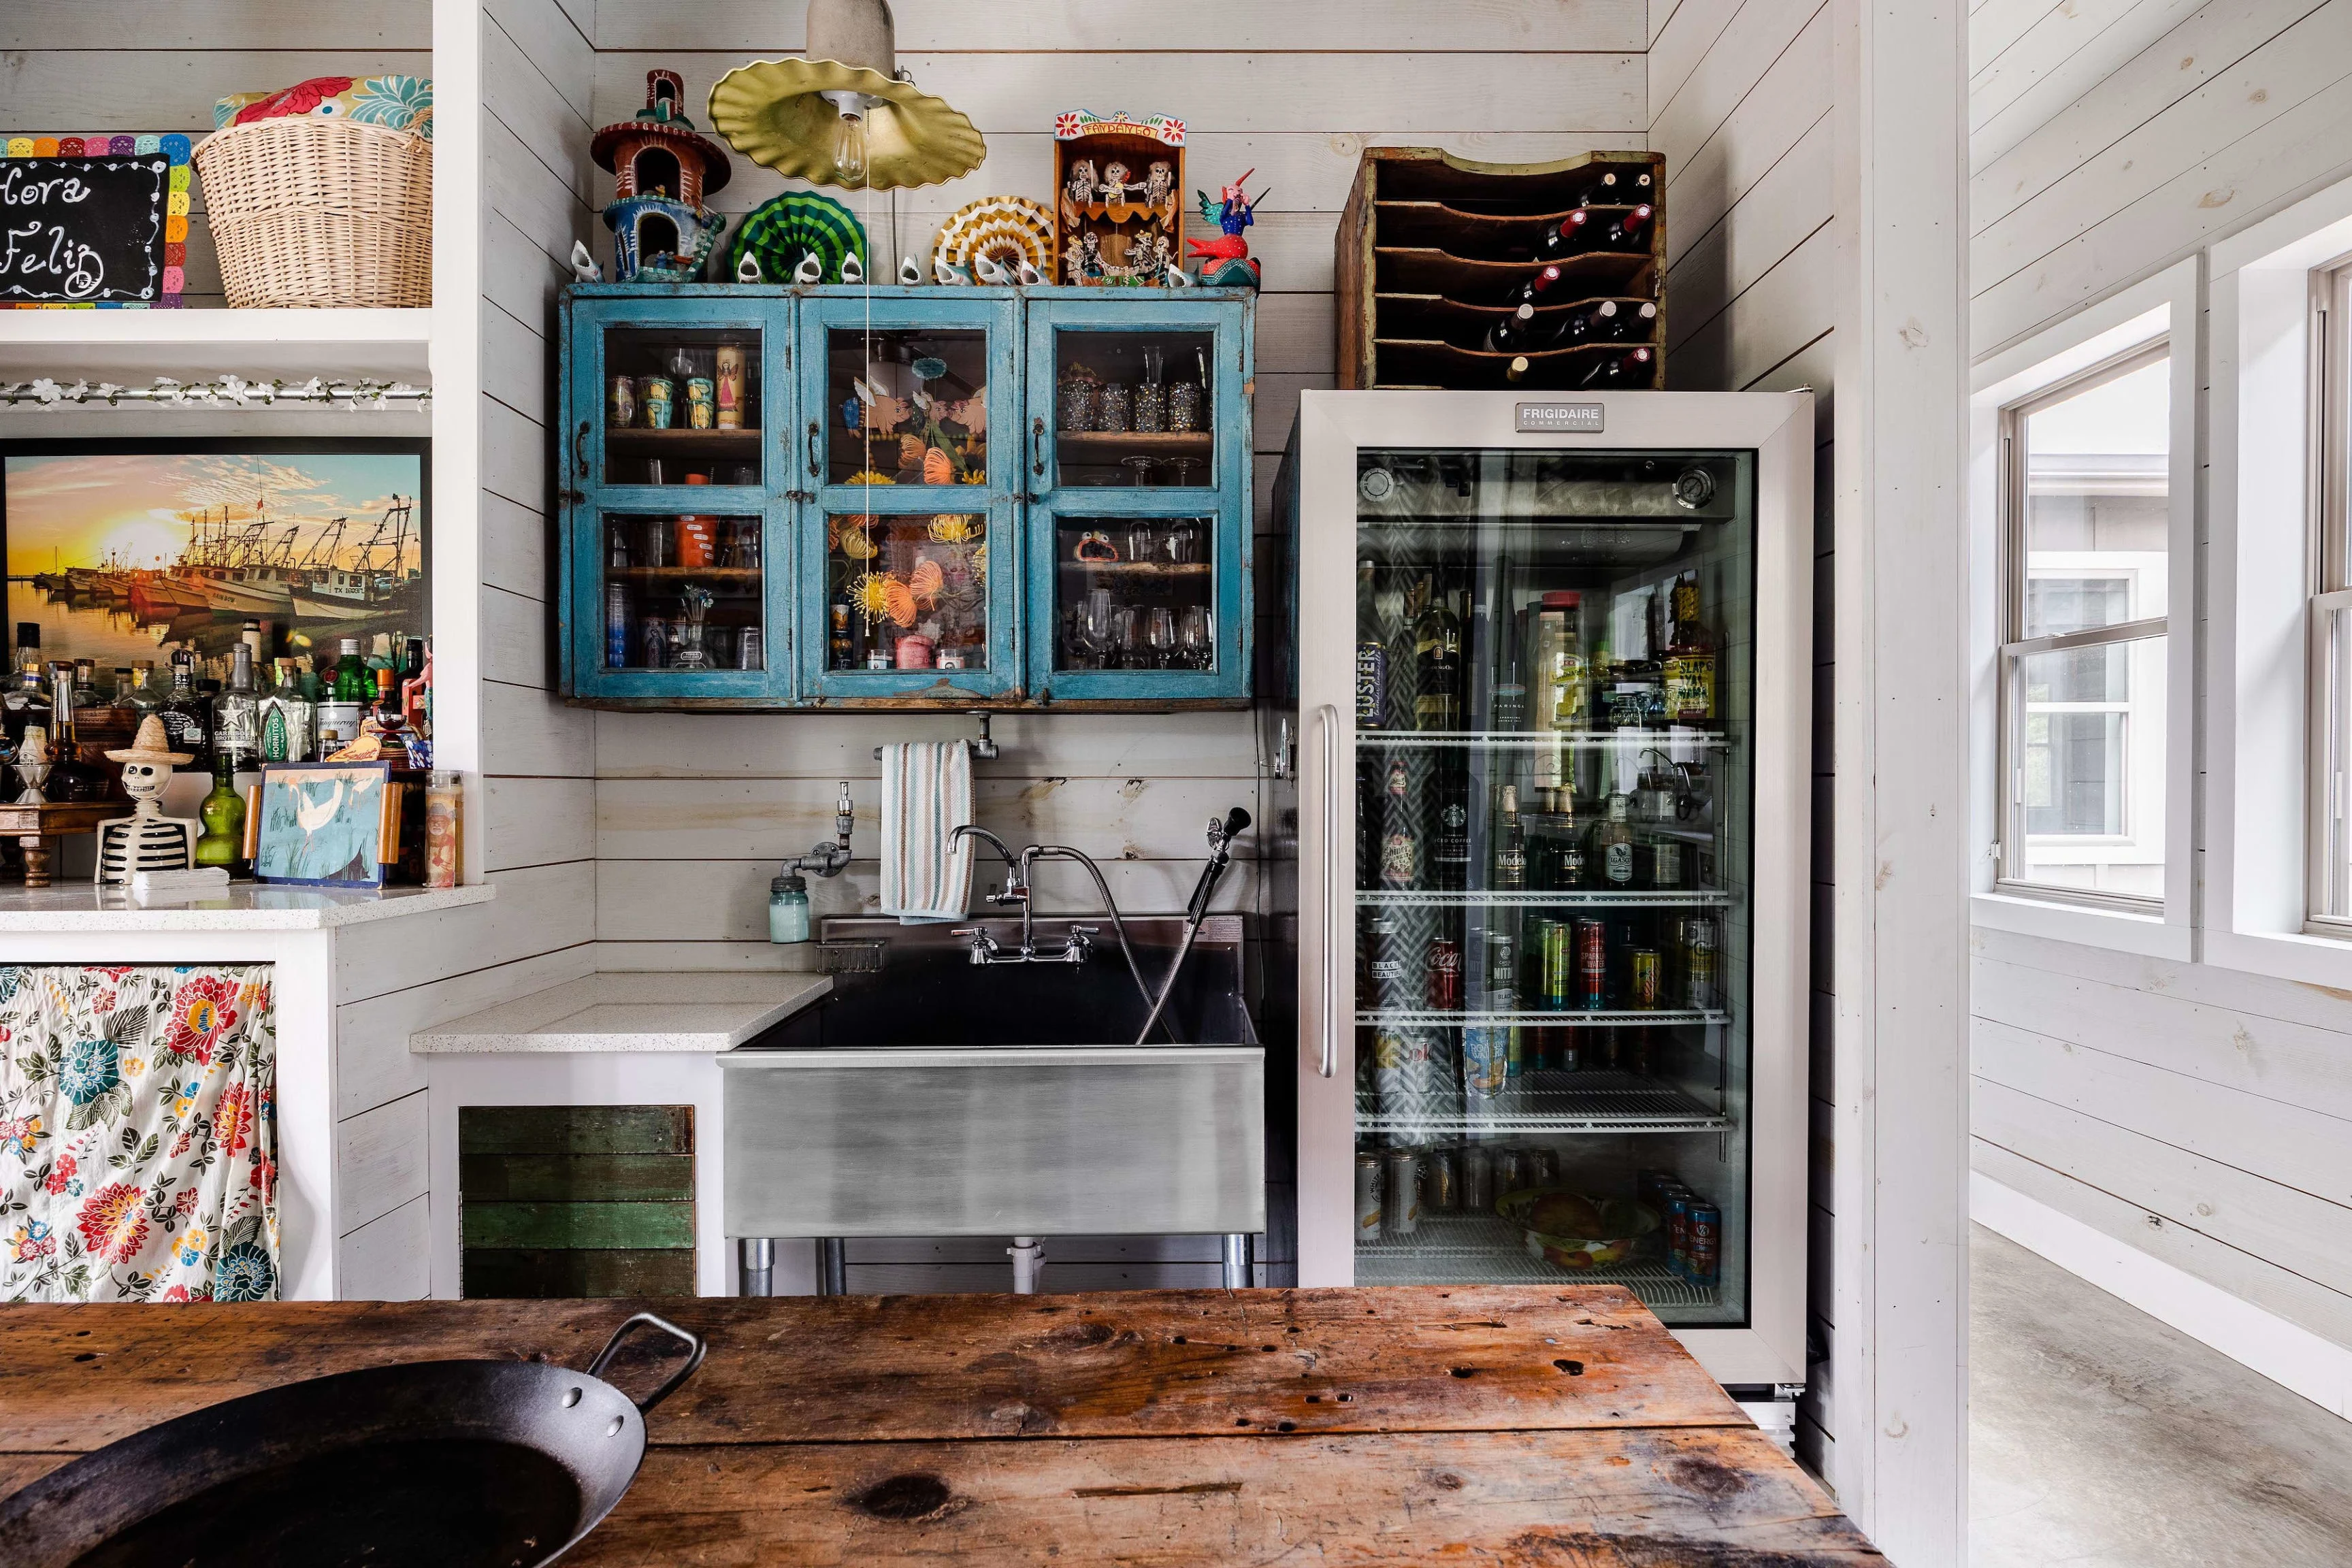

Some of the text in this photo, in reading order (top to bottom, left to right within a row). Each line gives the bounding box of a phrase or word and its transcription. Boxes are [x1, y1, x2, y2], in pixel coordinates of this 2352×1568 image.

[1086, 124, 1151, 136] FANDANGO
[1523, 408, 1599, 419] FRIGIDAIRE
[1679, 662, 1705, 674] SLAP
[1356, 649, 1375, 717] LUSTER
[319, 718, 356, 728] Tanqueray
[336, 748, 377, 761] Squirt
[1498, 854, 1527, 866] Modelo
[1494, 967, 1513, 979] NITR
[1698, 1225, 1708, 1236] V8
